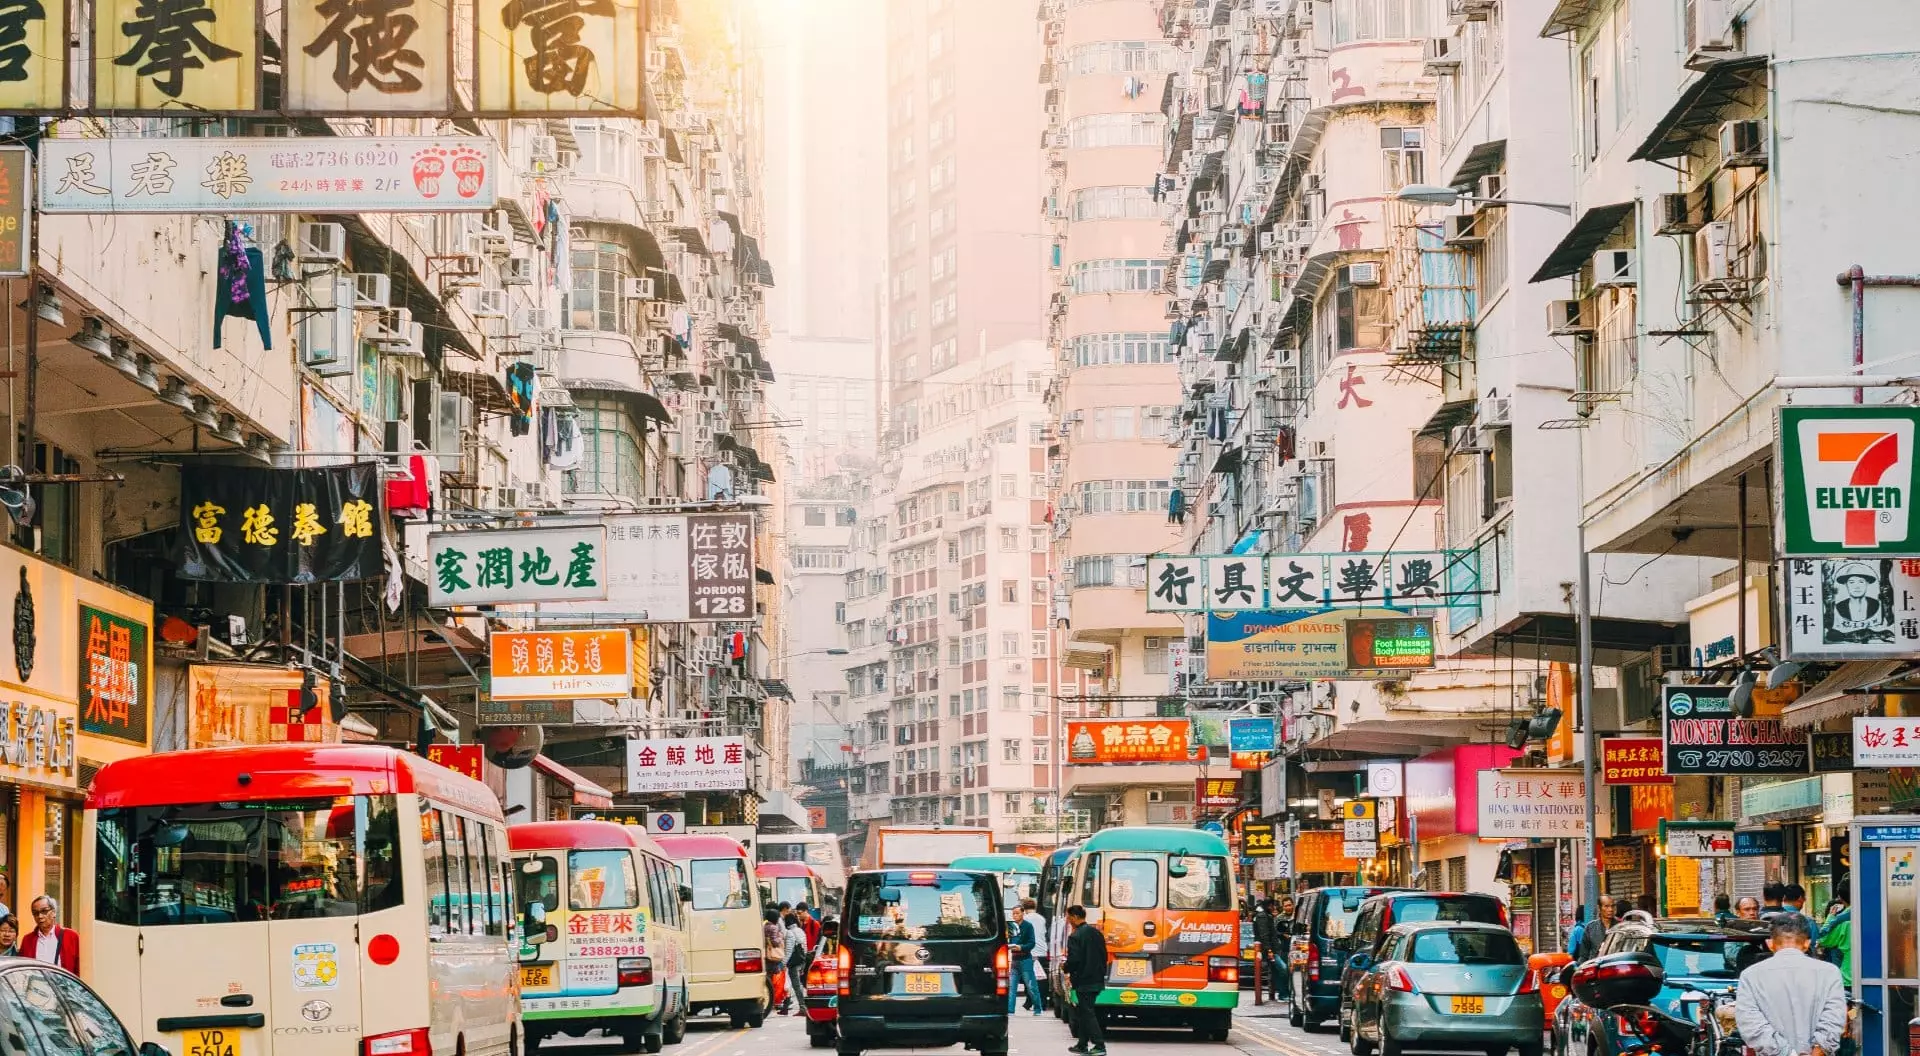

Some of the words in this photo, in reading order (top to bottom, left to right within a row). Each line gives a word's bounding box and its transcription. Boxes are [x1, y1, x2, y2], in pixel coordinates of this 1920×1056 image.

[354, 150, 399, 167] 6920
[375, 178, 401, 191] 2/F
[192, 500, 374, 546] 富德拳館
[690, 522, 749, 550] 佐敦
[435, 541, 598, 594] 家潤地產
[690, 553, 749, 580] 傢俬
[694, 585, 746, 595] JORDON
[694, 596, 746, 614] 128
[1243, 623, 1294, 634] DYNAMIC
[1298, 623, 1341, 634] TRAVELS
[1375, 640, 1394, 648] Foot
[511, 636, 603, 675] 頭頭是道
[1375, 648, 1395, 656] Body
[1669, 718, 1725, 744] MONEY
[1706, 750, 1754, 767] 2780
[1758, 750, 1806, 767] 3287
[655, 770, 671, 778] King
[674, 769, 703, 778] Property
[705, 768, 730, 776] Agency
[1621, 767, 1645, 778] 2787
[1488, 804, 1510, 814] HING
[1512, 804, 1532, 814] WAH
[1534, 804, 1584, 814] STATIONERY
[568, 912, 633, 934] 金寶來
[1181, 922, 1233, 932] LALAMOVE
[580, 946, 645, 957] 23882918
[527, 969, 543, 979] FG
[907, 983, 939, 993] 3858
[1139, 992, 1157, 1001] 2751
[273, 1024, 360, 1036] COASTER
[200, 1030, 225, 1046] VD
